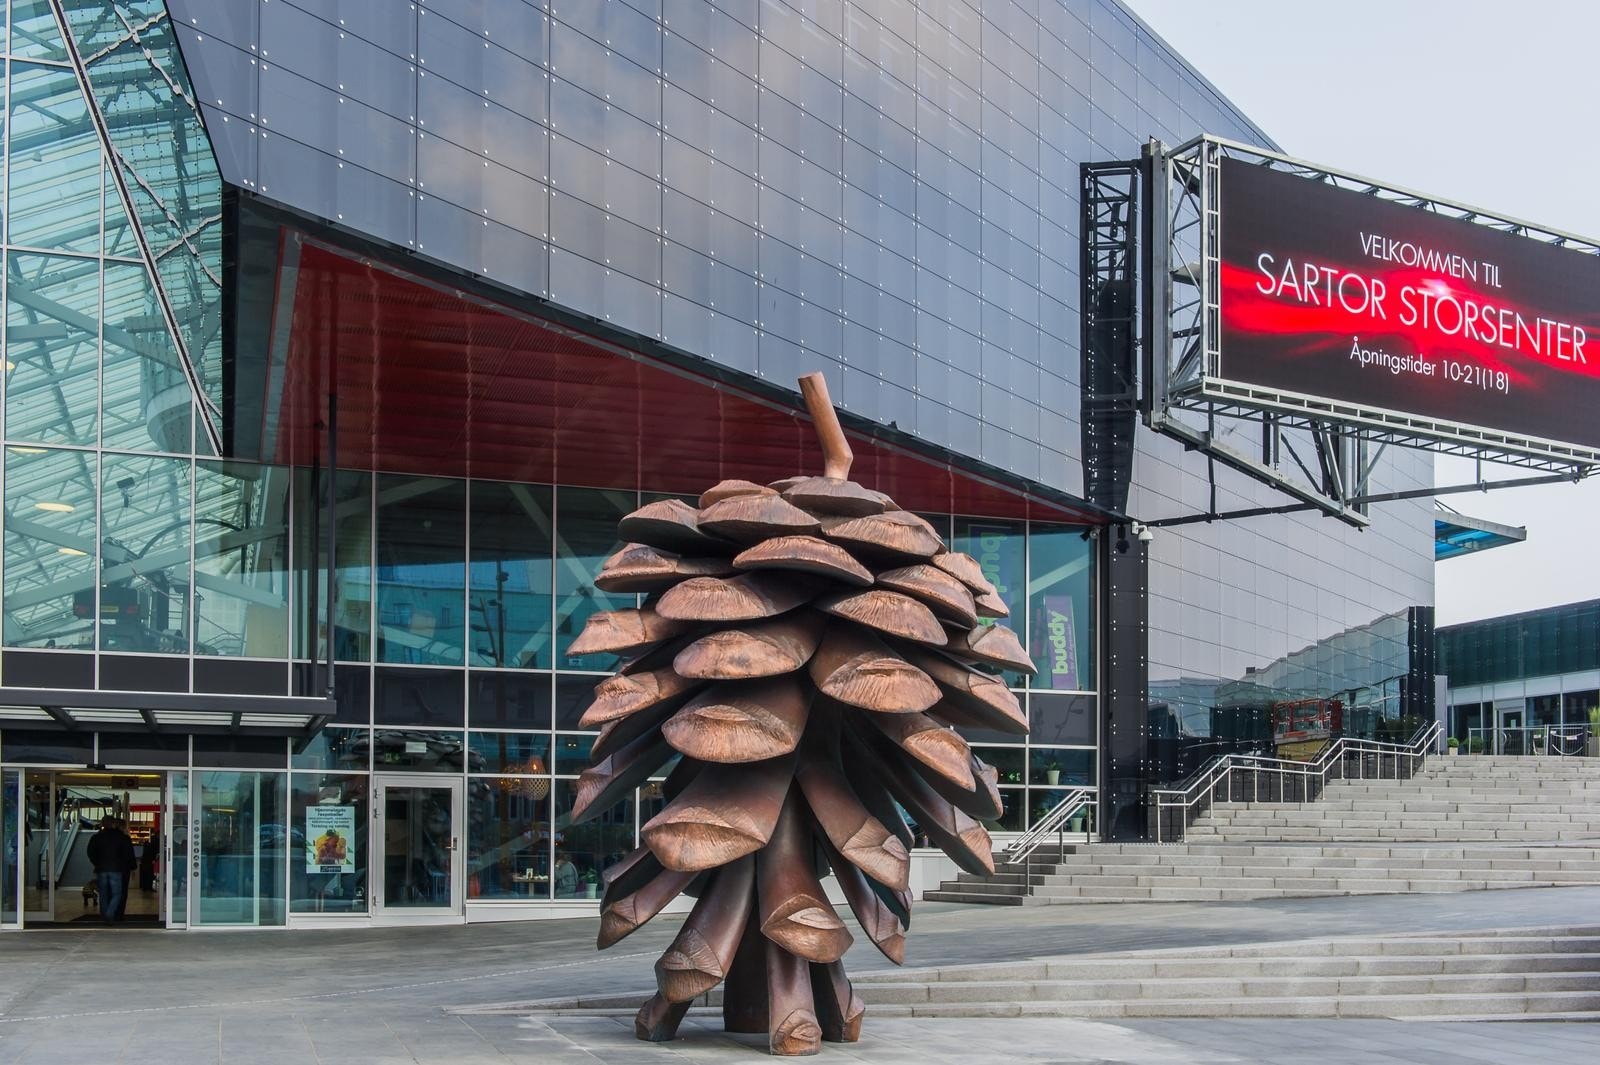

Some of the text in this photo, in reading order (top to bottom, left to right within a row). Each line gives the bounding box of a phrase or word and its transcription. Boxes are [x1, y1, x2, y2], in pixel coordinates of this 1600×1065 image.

[1360, 231, 1502, 288] VELKOMMEN TIL
[1256, 252, 1587, 364] SARTOR STORSENTER
[1350, 336, 1510, 395] Åpningstider 10-21(18)
[1047, 610, 1068, 675] buddy
